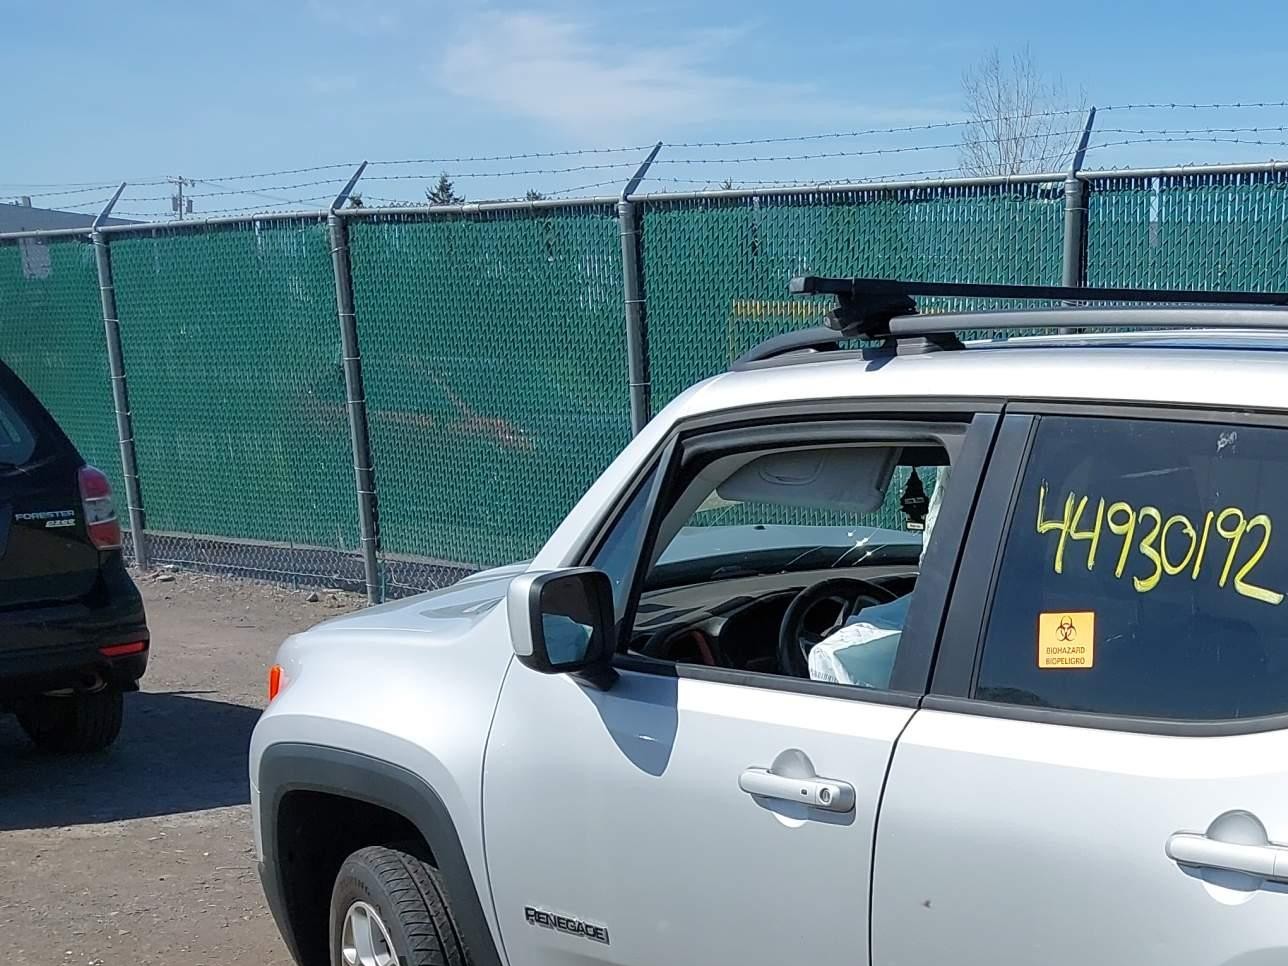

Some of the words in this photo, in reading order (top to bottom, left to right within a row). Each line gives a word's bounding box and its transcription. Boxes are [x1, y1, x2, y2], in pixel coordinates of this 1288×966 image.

[15, 509, 75, 520] FORESTER
[1035, 478, 1286, 606] 44930192
[1046, 646, 1086, 655] BIOHAZARD
[1045, 656, 1086, 665] BIOPELIGRO
[524, 906, 611, 945] RENEGADE
